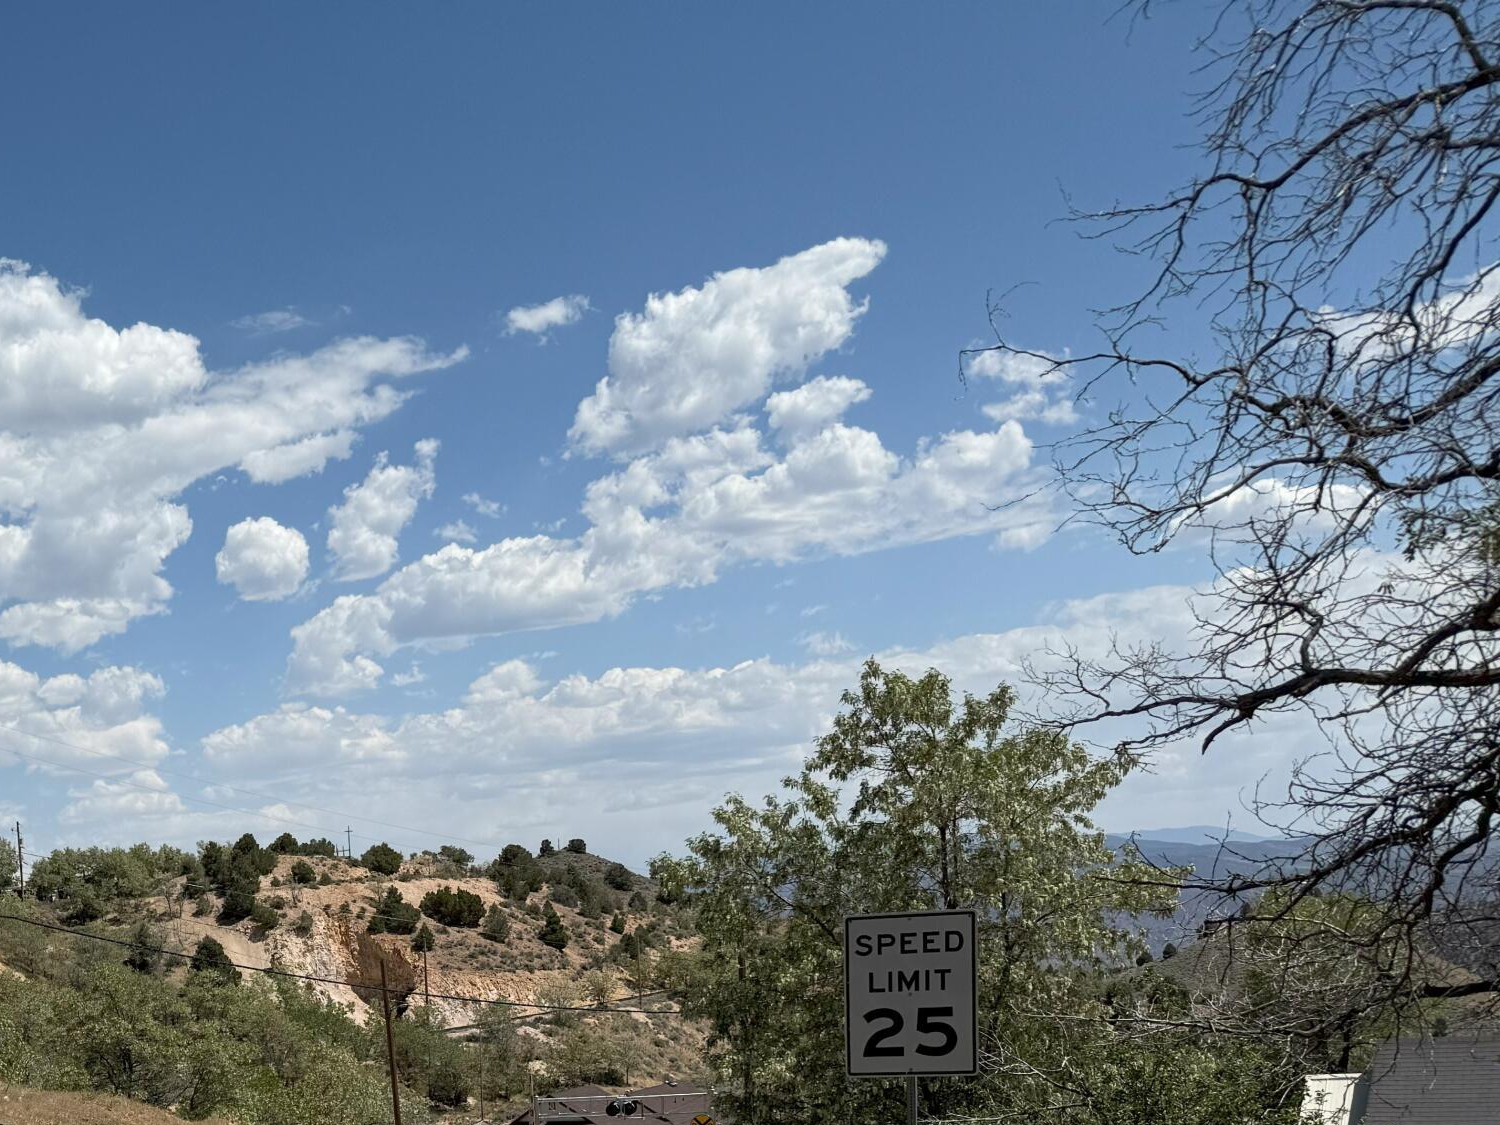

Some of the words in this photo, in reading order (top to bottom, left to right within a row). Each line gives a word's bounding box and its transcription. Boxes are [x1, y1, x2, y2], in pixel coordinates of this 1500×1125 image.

[855, 931, 964, 956] SPEED
[868, 969, 952, 993] LIMIT
[862, 1006, 958, 1058] 25
